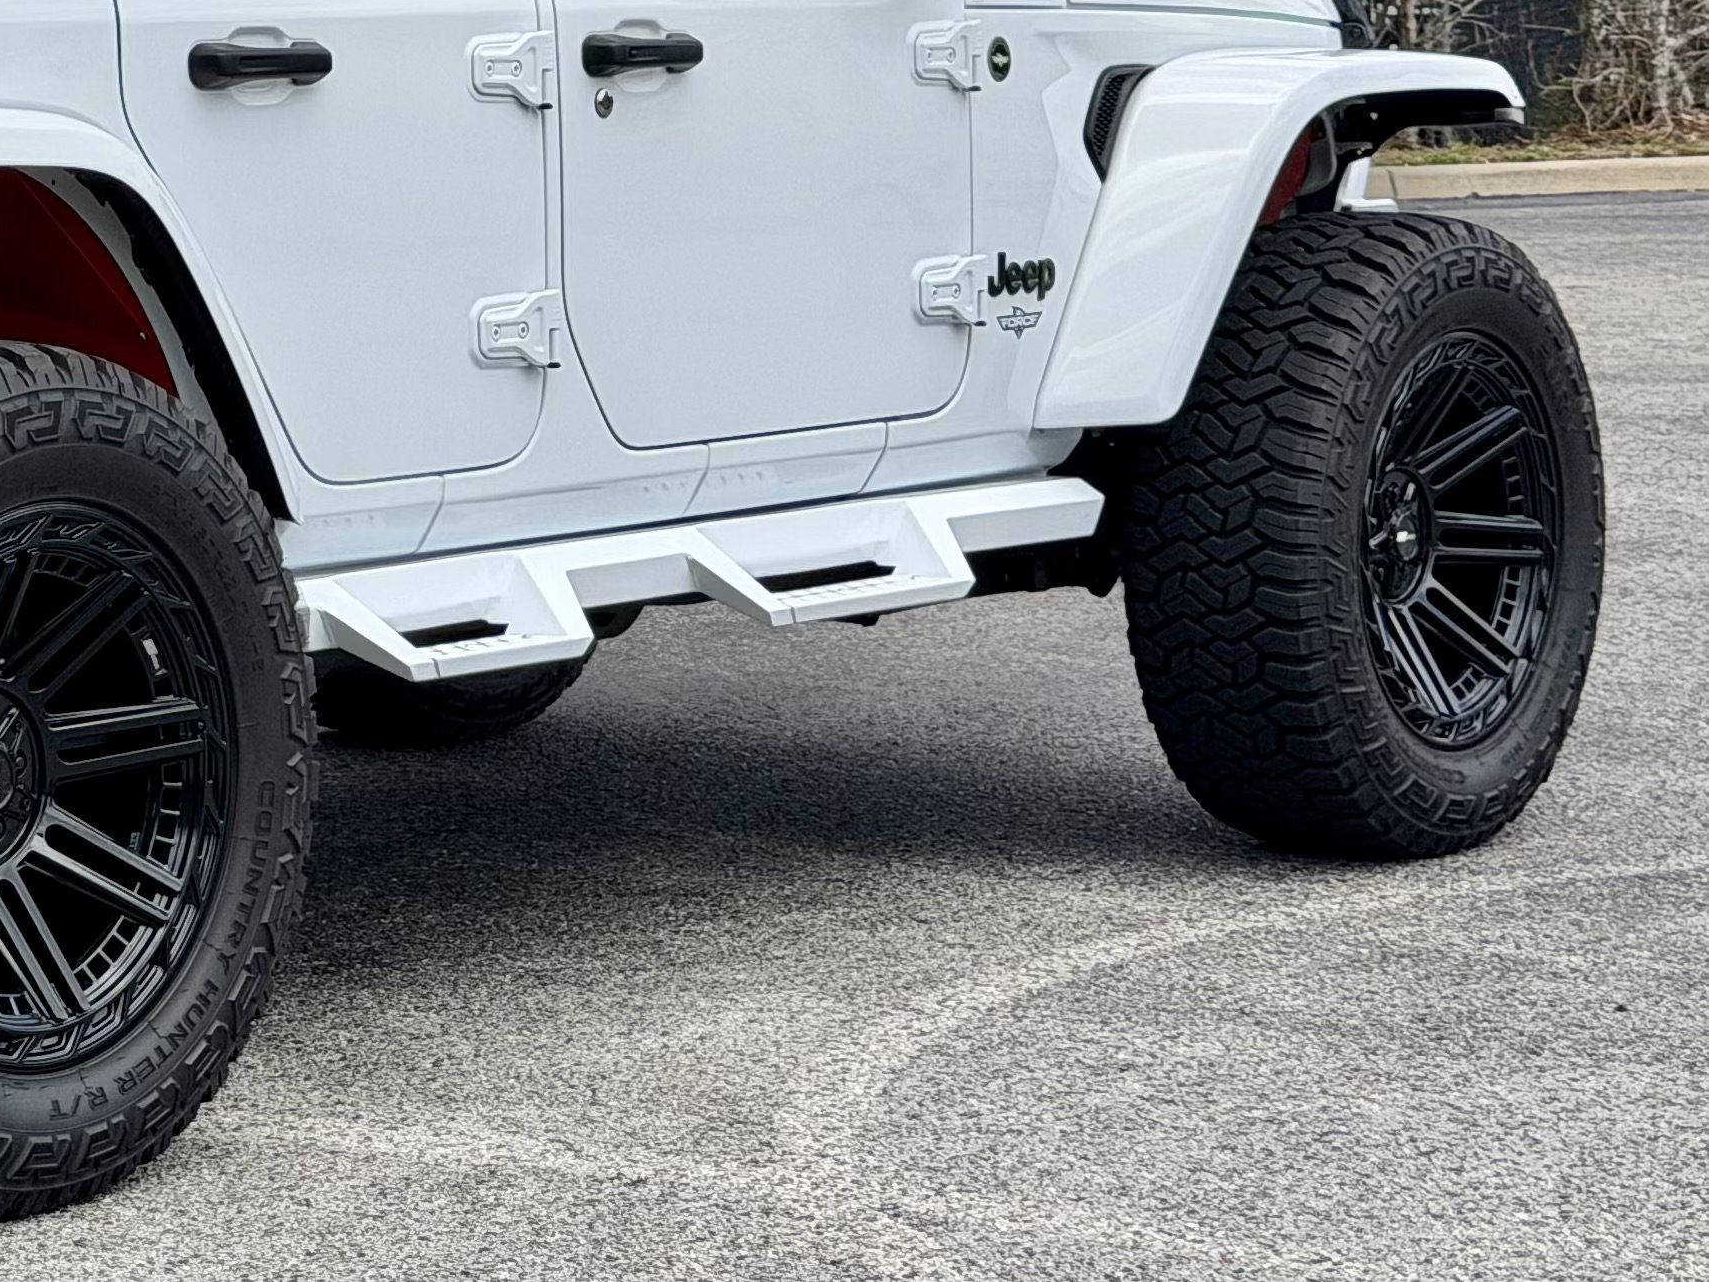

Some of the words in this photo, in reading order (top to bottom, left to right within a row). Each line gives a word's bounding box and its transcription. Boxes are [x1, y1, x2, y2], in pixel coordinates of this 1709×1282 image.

[988, 252, 1056, 301] Jeep
[216, 781, 275, 975] COUNTRY
[112, 978, 219, 1097] HUNTER
[49, 1087, 109, 1122] R/T
